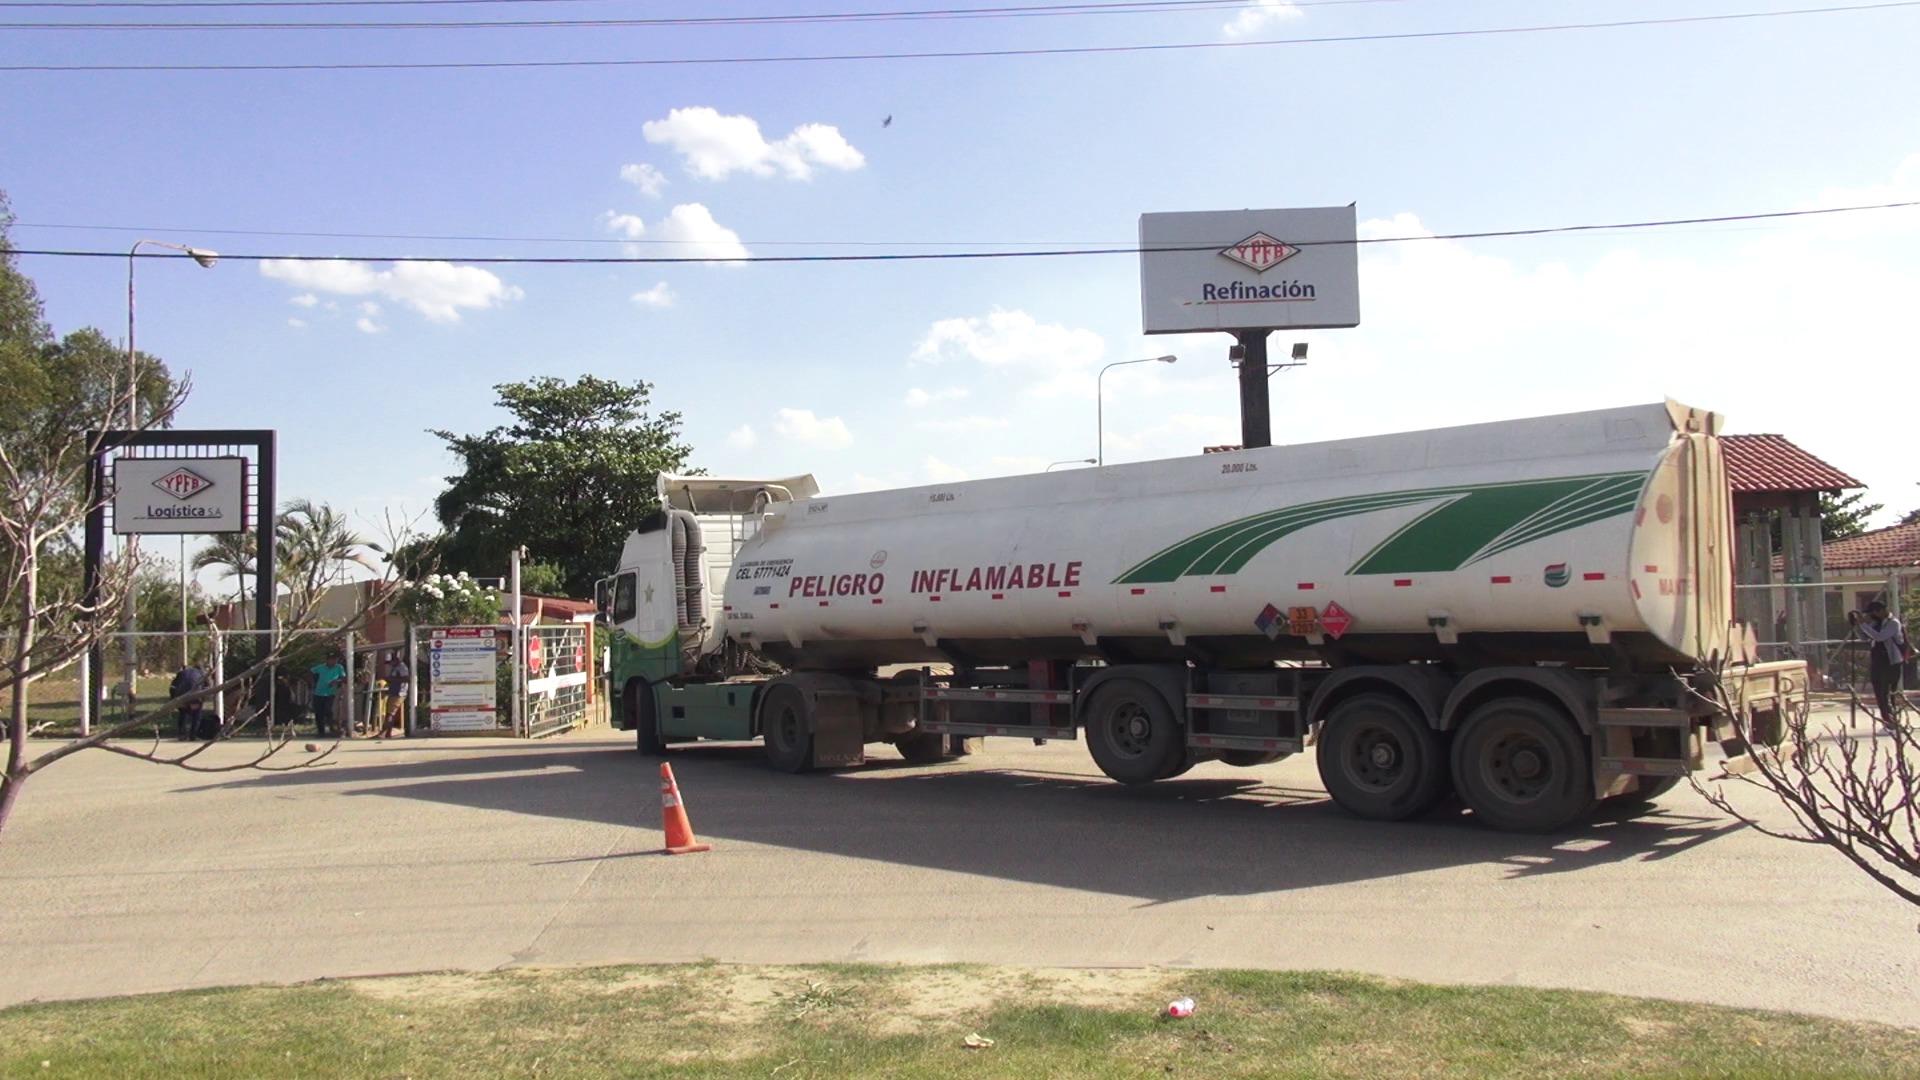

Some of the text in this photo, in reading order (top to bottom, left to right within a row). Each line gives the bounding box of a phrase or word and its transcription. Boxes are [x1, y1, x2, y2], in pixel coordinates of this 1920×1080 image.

[1236, 240, 1285, 264] YPFB
[1203, 279, 1316, 301] Refinación
[165, 474, 200, 493] YPFB
[147, 505, 205, 518] Logística
[753, 564, 791, 579] 67771424
[910, 561, 1083, 593] INFLAMABLE
[788, 572, 885, 598] PELIGRO
[1296, 608, 1308, 620] 33
[1292, 621, 1314, 634] 1203
